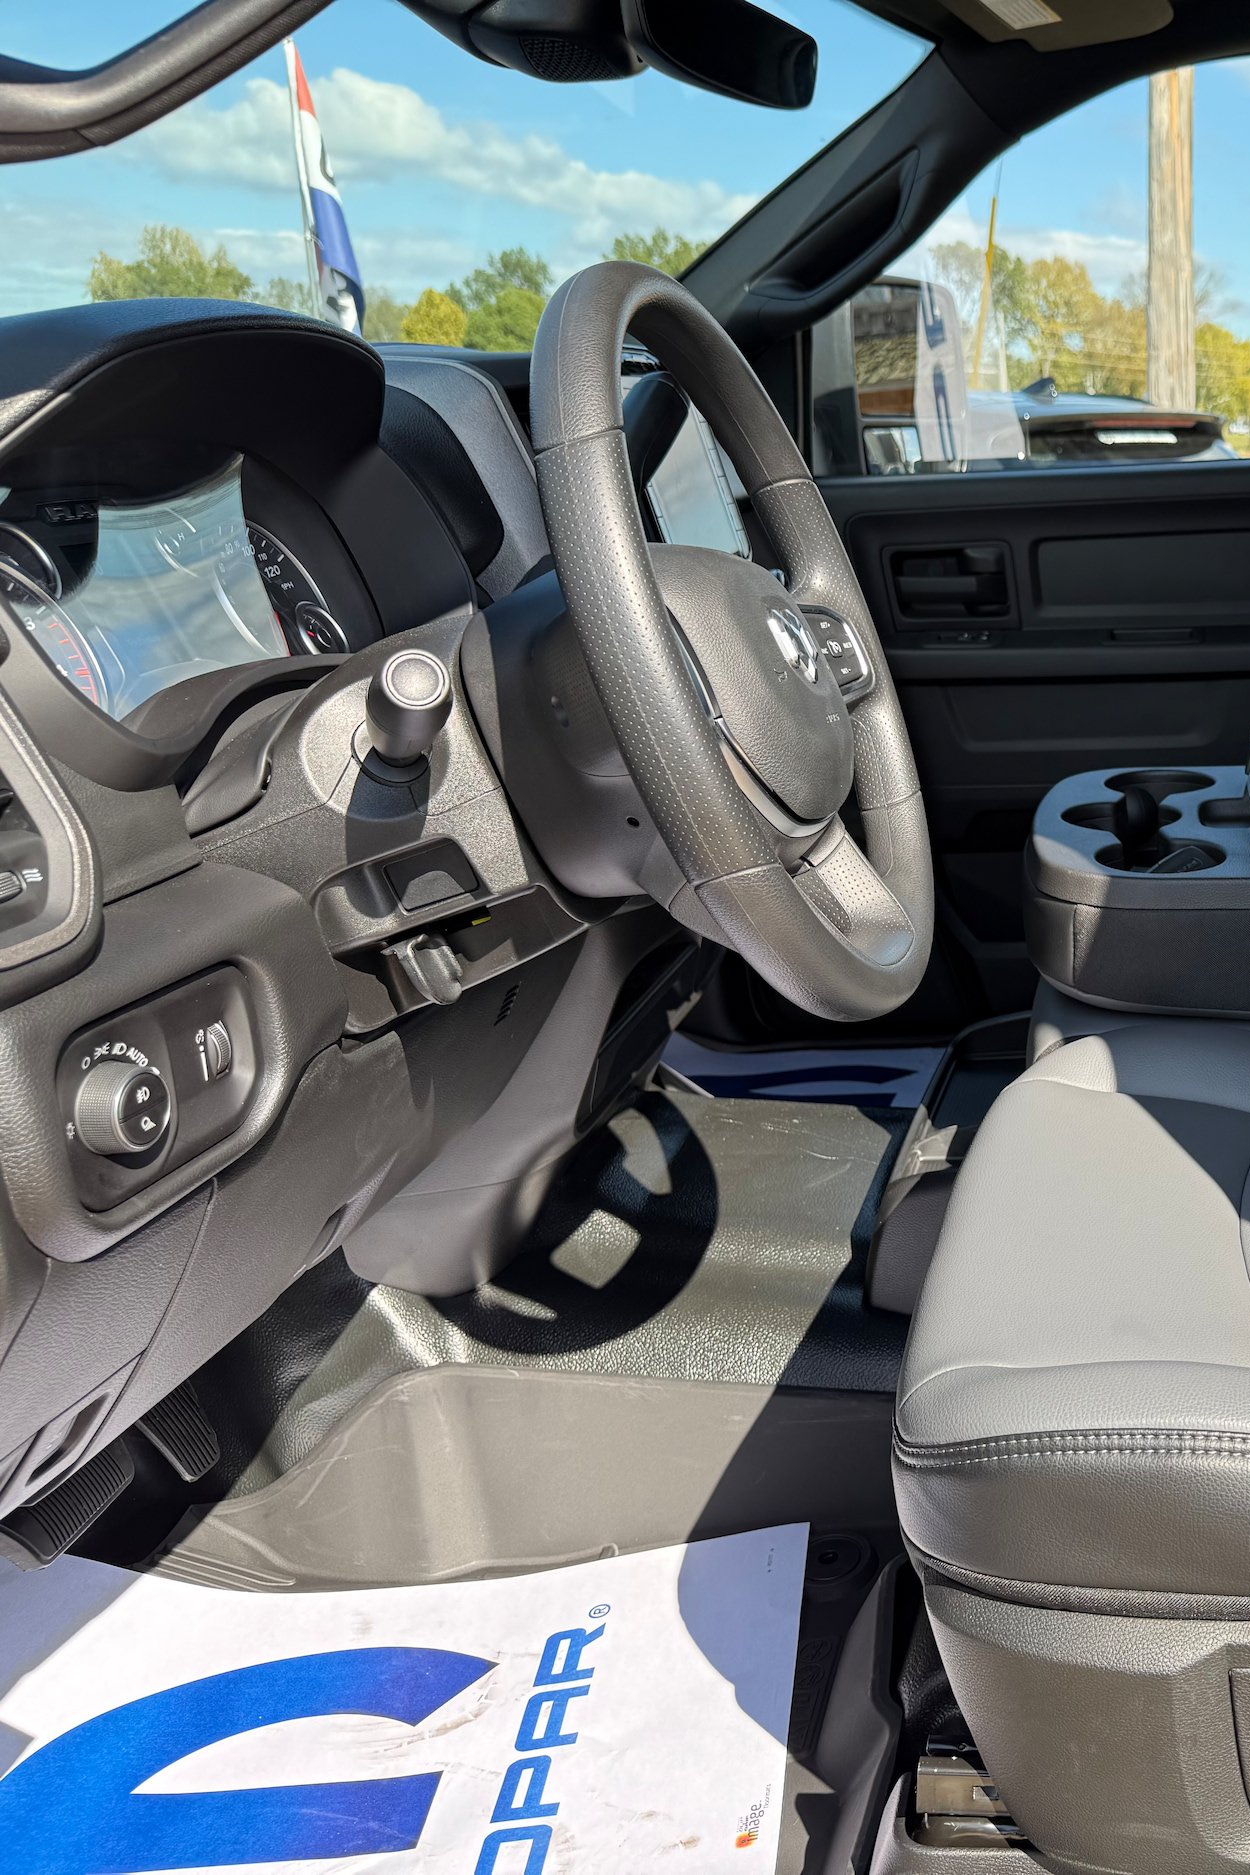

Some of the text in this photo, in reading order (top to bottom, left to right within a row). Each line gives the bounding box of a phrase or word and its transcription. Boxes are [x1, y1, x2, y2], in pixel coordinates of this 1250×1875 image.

[241, 544, 256, 558] 100
[264, 564, 281, 578] 120
[23, 616, 36, 631] 3
[126, 1047, 149, 1068] AUTO
